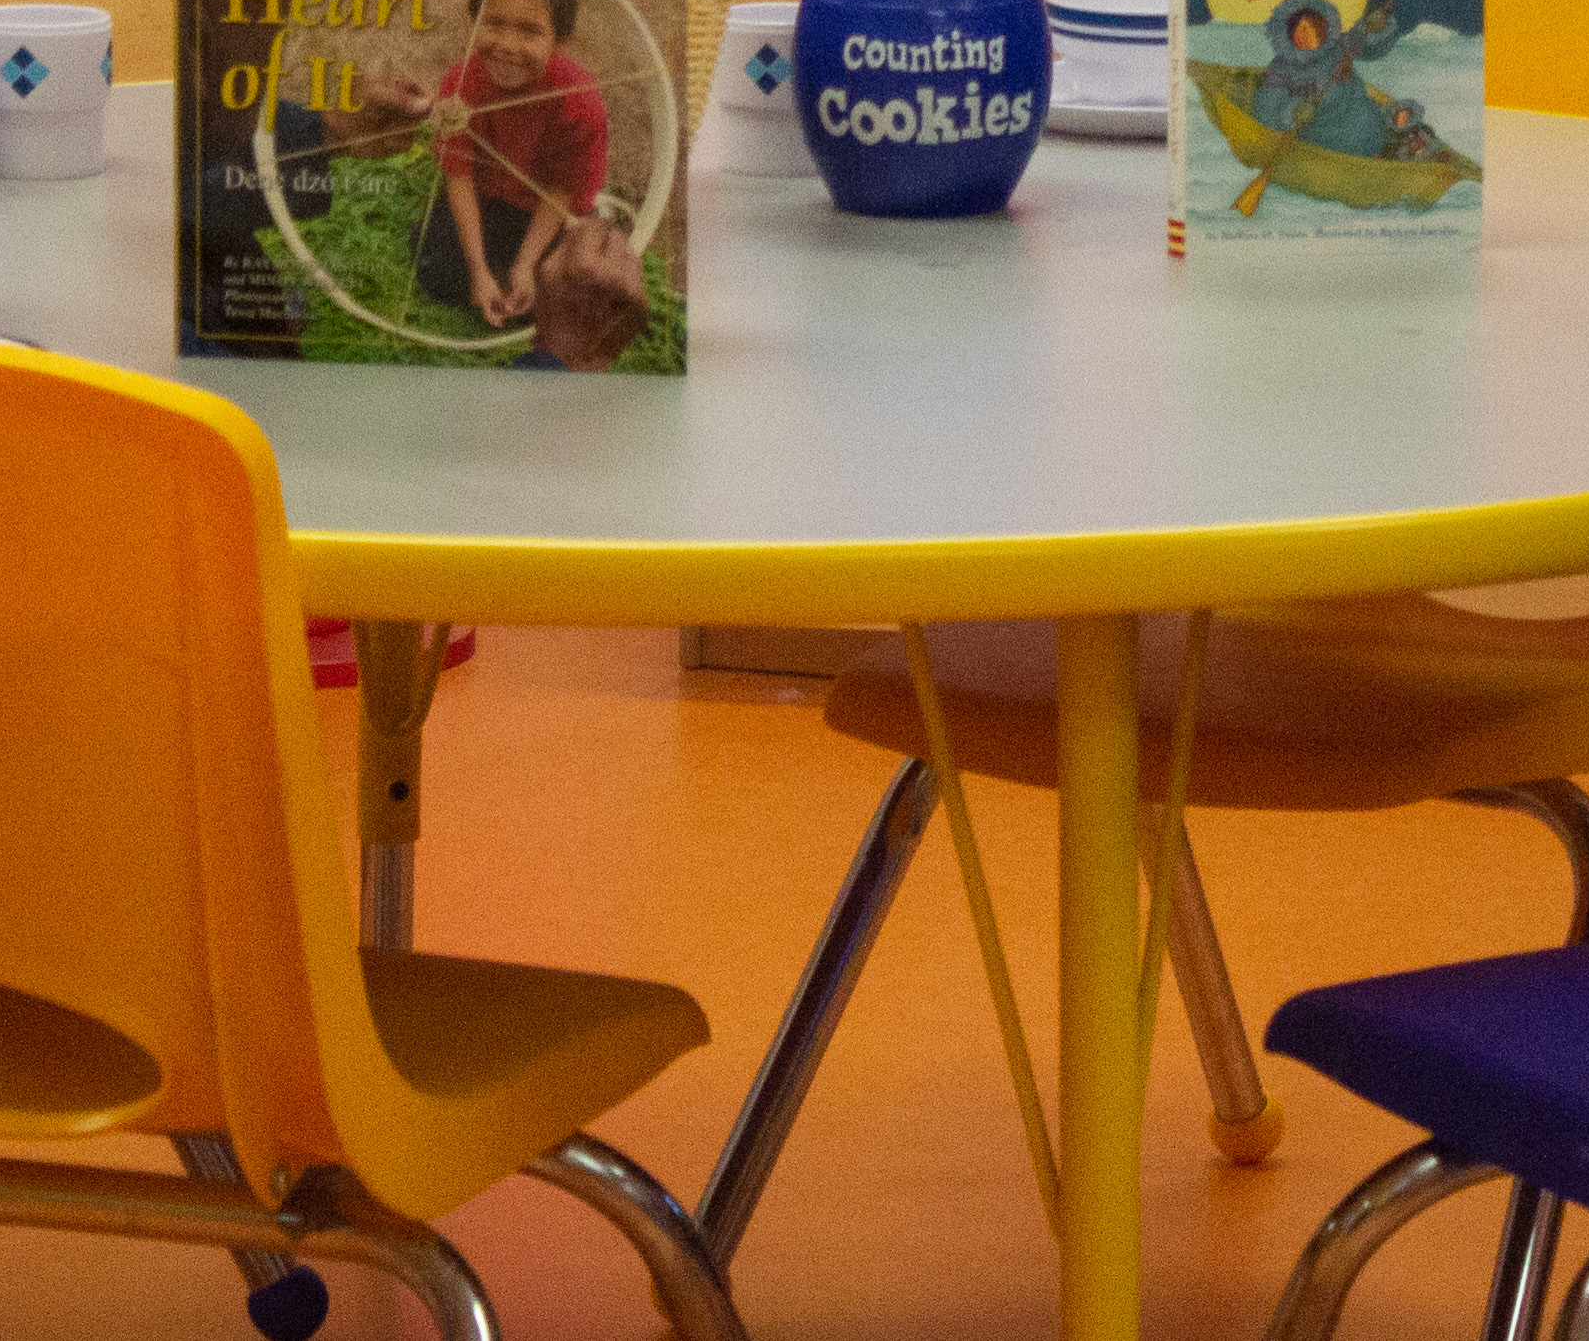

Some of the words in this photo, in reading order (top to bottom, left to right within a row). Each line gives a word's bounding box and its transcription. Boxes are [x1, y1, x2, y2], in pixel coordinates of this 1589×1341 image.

[220, 27, 295, 134] of
[304, 57, 365, 113] It
[843, 28, 1006, 75] Counting
[818, 79, 1033, 146] Cookies
